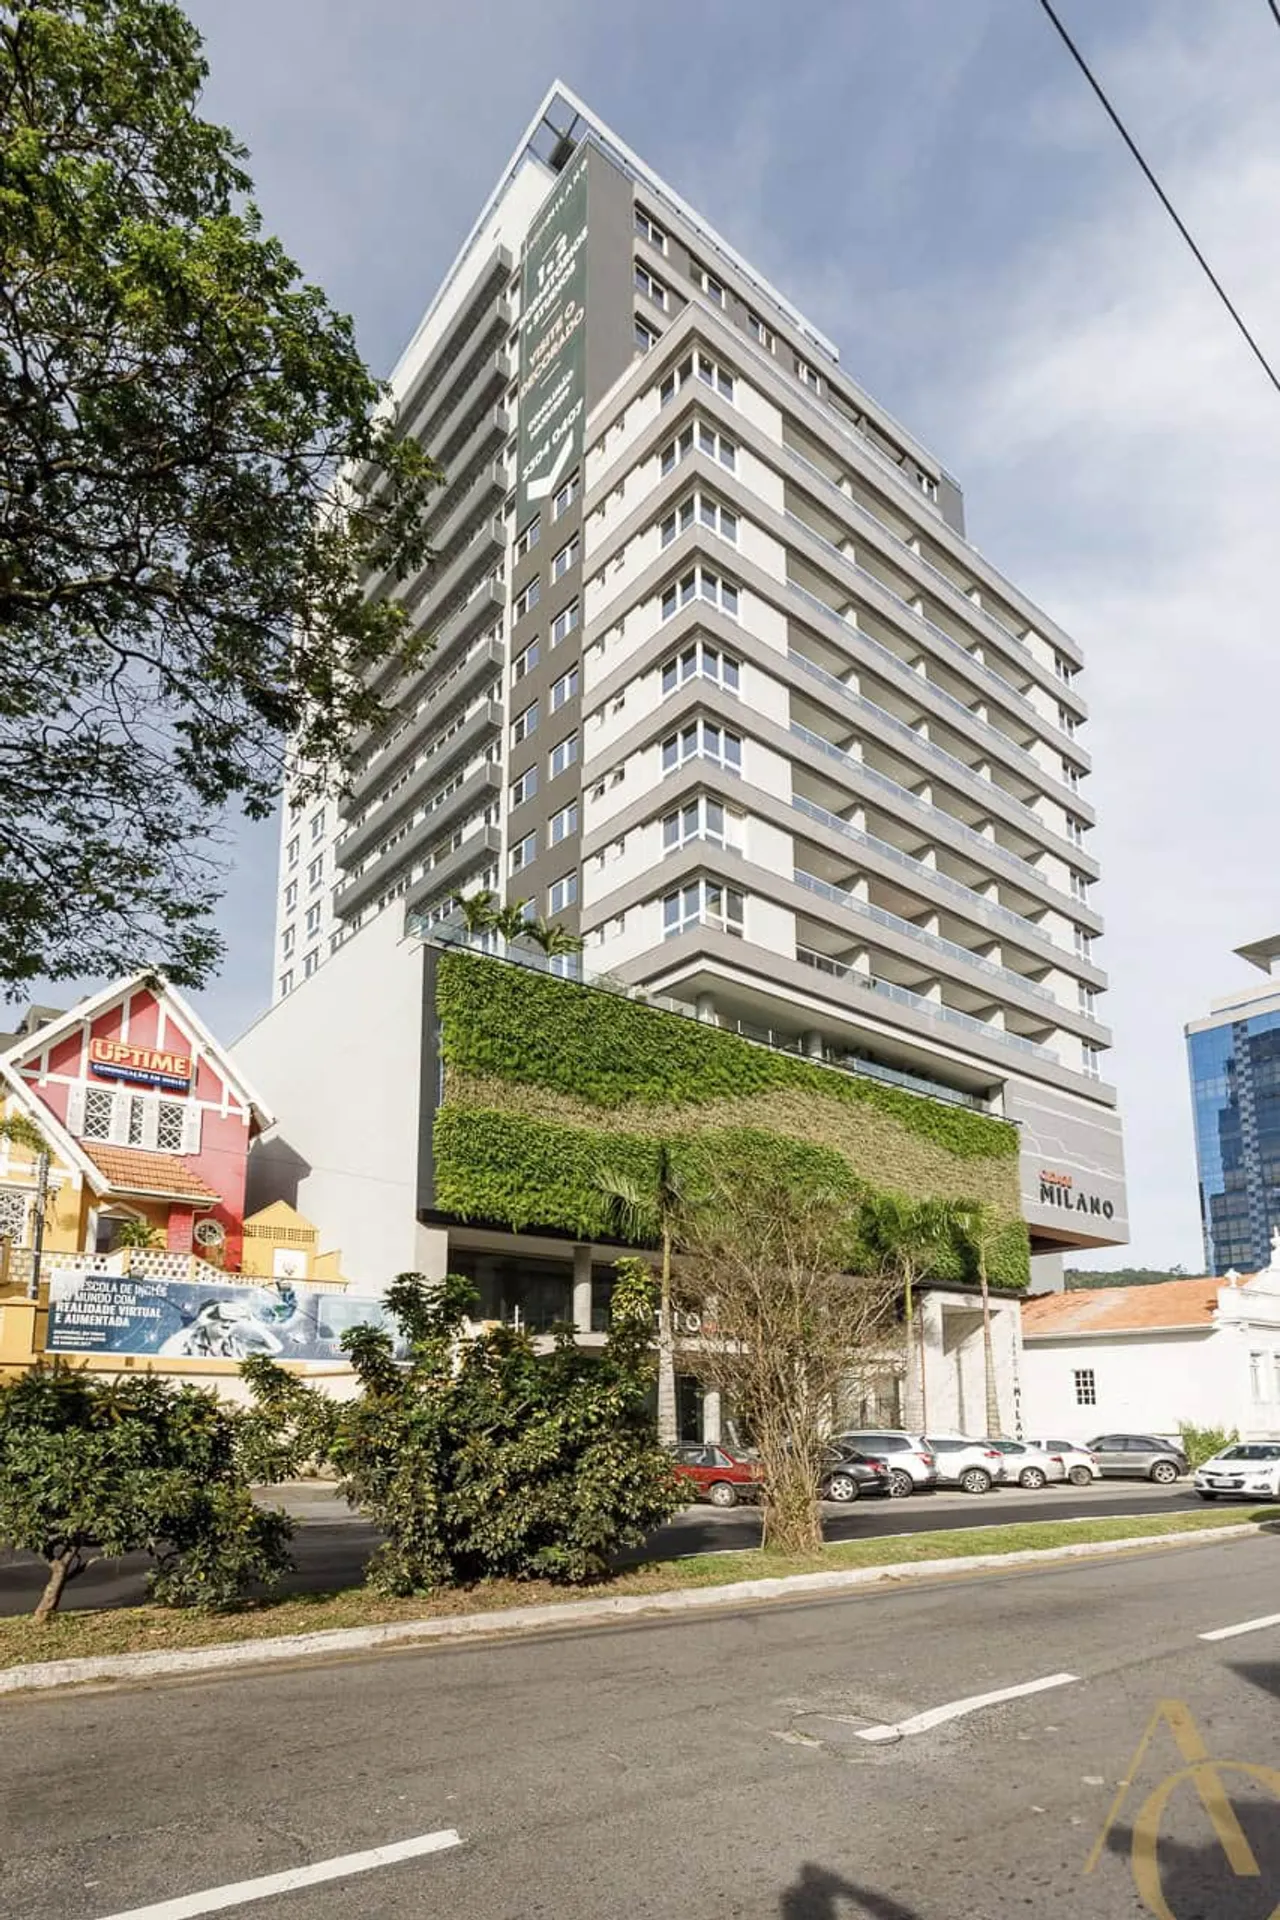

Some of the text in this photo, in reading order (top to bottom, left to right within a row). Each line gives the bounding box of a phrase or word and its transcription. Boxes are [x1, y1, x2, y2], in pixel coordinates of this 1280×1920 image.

[564, 300, 575, 320] O
[519, 306, 585, 401] DECORADO
[95, 1042, 186, 1075] UPTIME
[1040, 1183, 1114, 1220] MILANO
[81, 1281, 118, 1294] ESCOLA
[120, 1284, 134, 1294] DE
[75, 1291, 112, 1304] MUNDO
[113, 1294, 137, 1305] COM
[56, 1301, 162, 1318] REALIDADE VIRTUAL
[54, 1312, 131, 1328] E AUMENTADA
